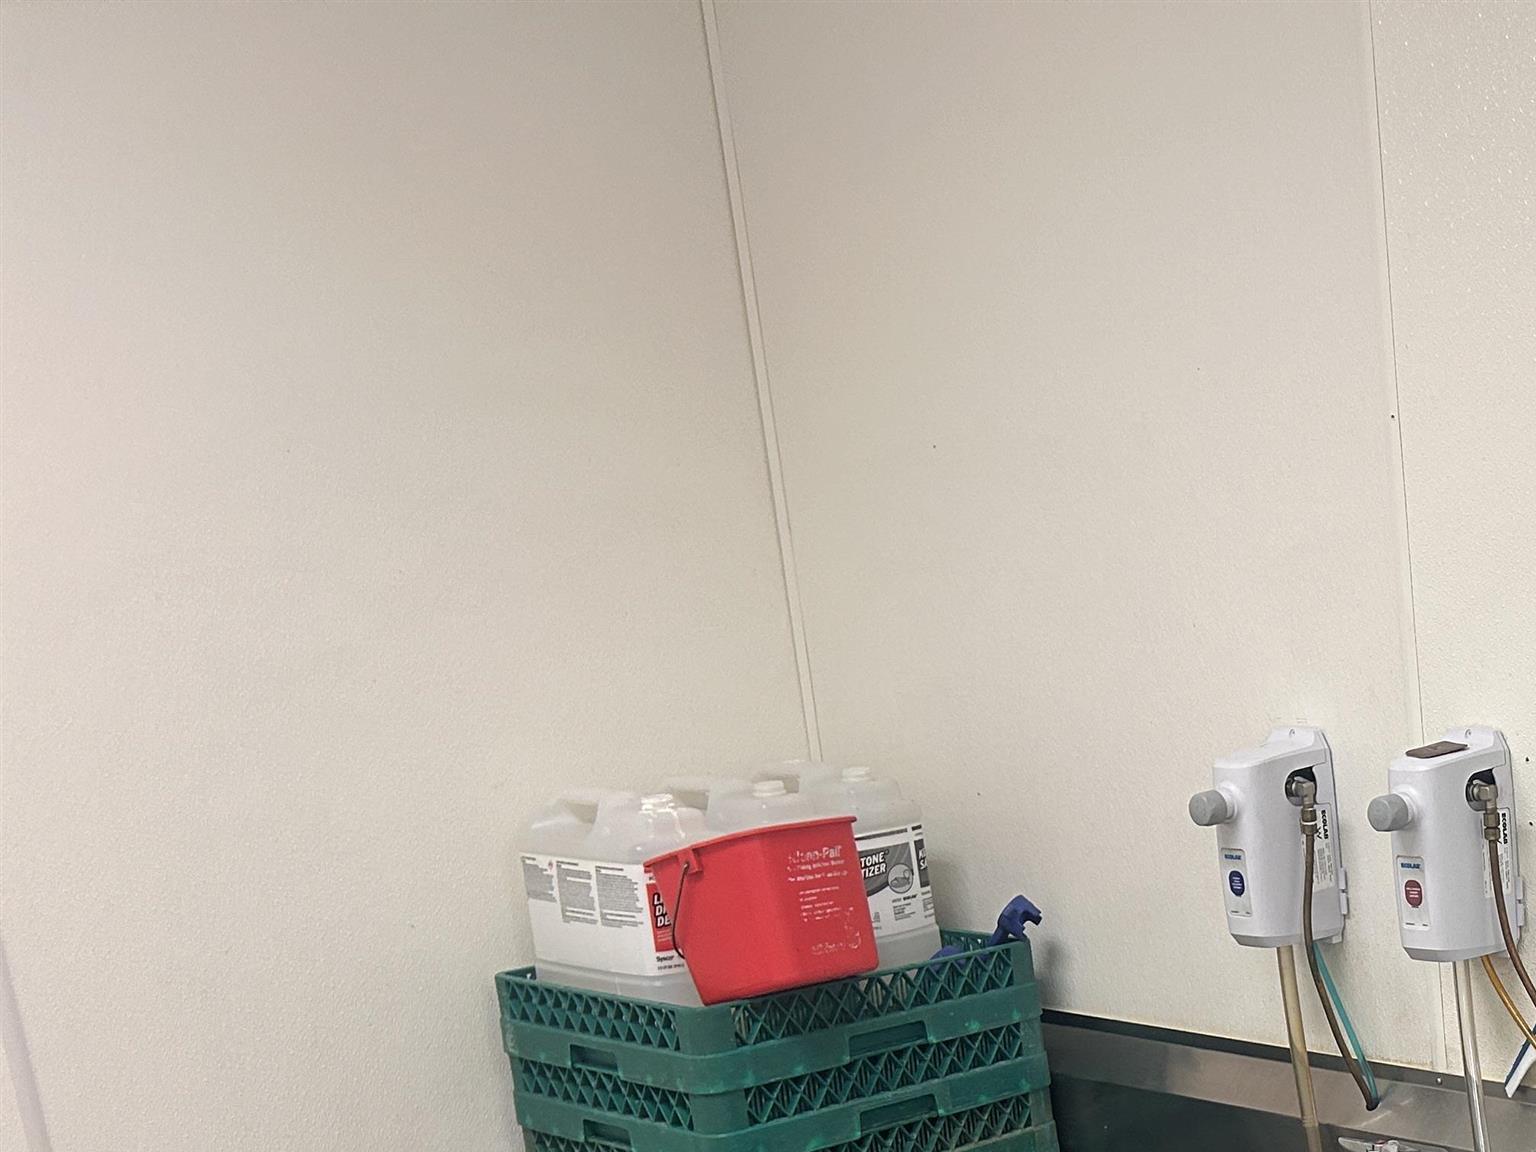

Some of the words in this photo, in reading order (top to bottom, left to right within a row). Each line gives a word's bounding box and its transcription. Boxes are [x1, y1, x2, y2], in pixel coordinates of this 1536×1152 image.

[1320, 809, 1329, 840] ECOLAB
[1501, 812, 1509, 845] ECOLAB
[1400, 862, 1421, 870] ECOLAB
